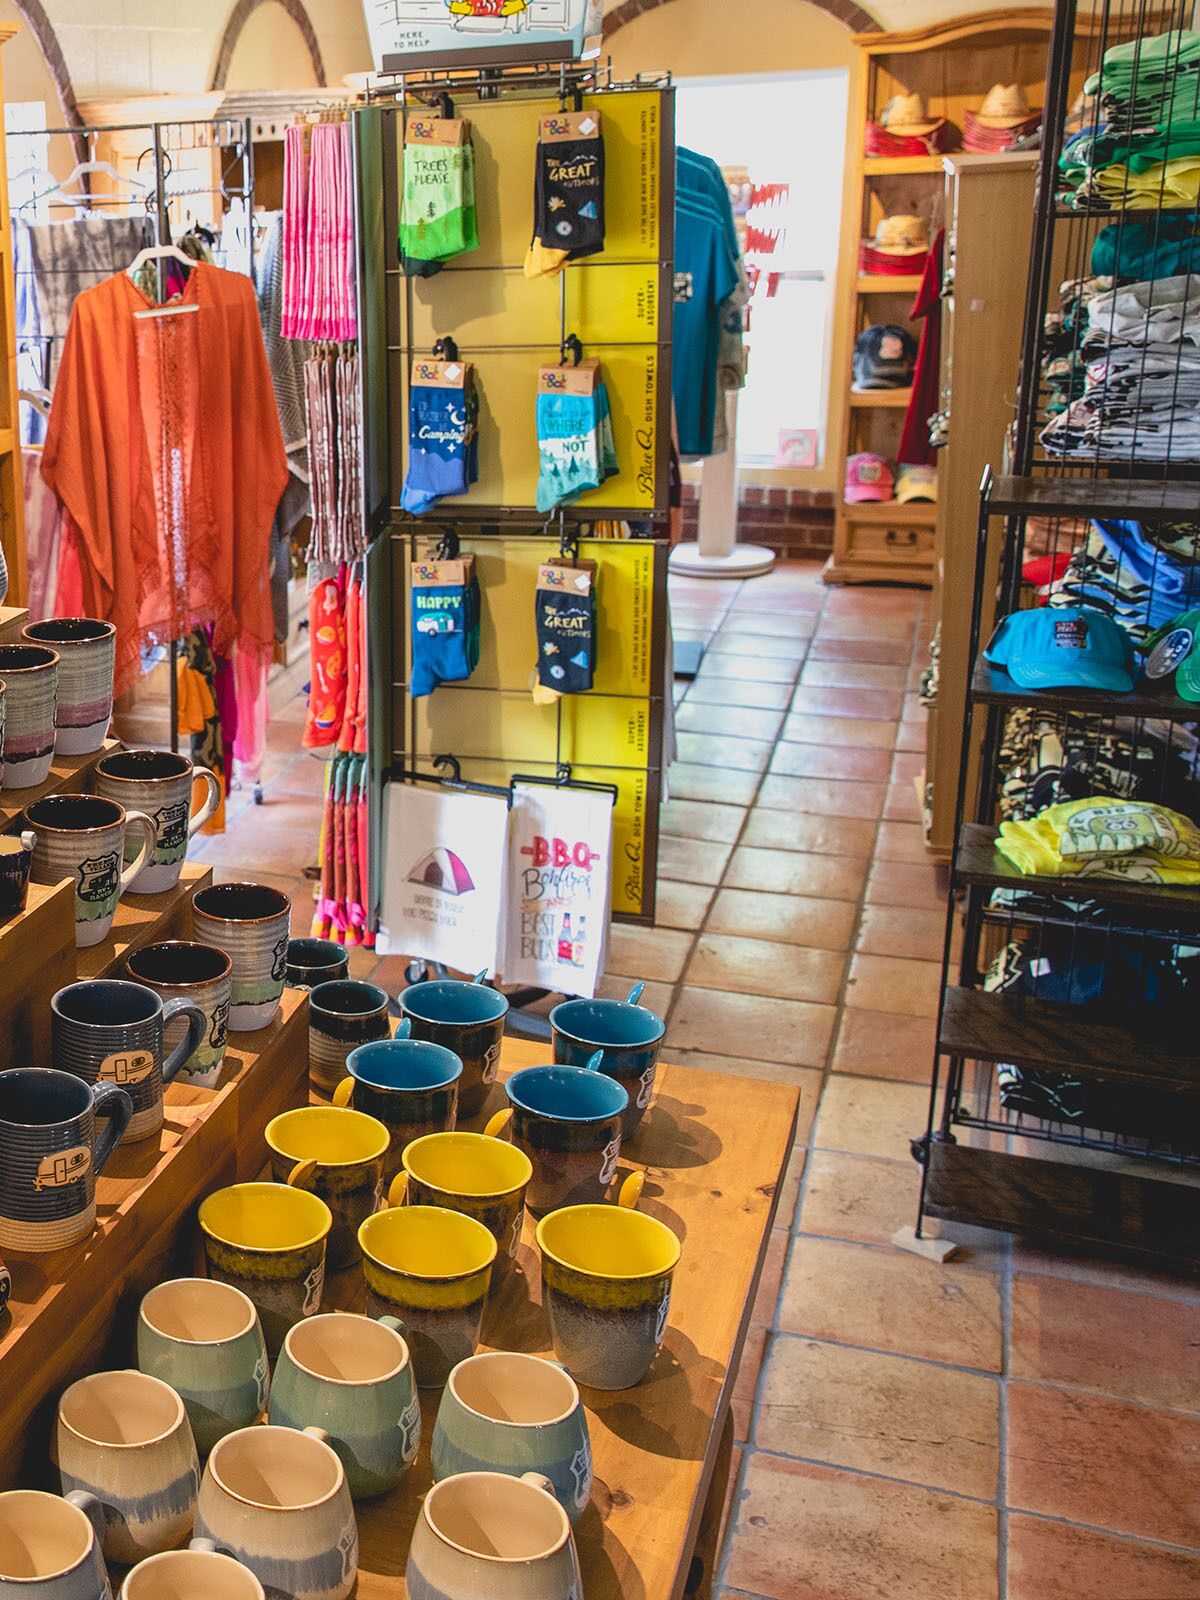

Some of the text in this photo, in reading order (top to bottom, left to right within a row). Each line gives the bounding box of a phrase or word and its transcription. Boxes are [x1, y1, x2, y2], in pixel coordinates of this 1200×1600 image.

[399, 31, 423, 39] HERE
[408, 39, 430, 48] HELP
[414, 159, 448, 173] TREES
[549, 162, 595, 181] GREAT
[414, 173, 450, 186] PLEASE
[646, 280, 655, 326] ABSORBENT
[646, 355, 654, 394] TOWELS
[645, 399, 653, 422] DISH
[418, 424, 466, 444] Camping
[562, 440, 589, 453] NOT
[637, 453, 654, 499] Blue
[416, 595, 461, 609] HAPPY
[544, 615, 588, 628] GREAT
[634, 778, 643, 813] TOWELS
[633, 816, 641, 837] DISH
[531, 835, 593, 872] BBQ
[521, 912, 556, 936] BEST
